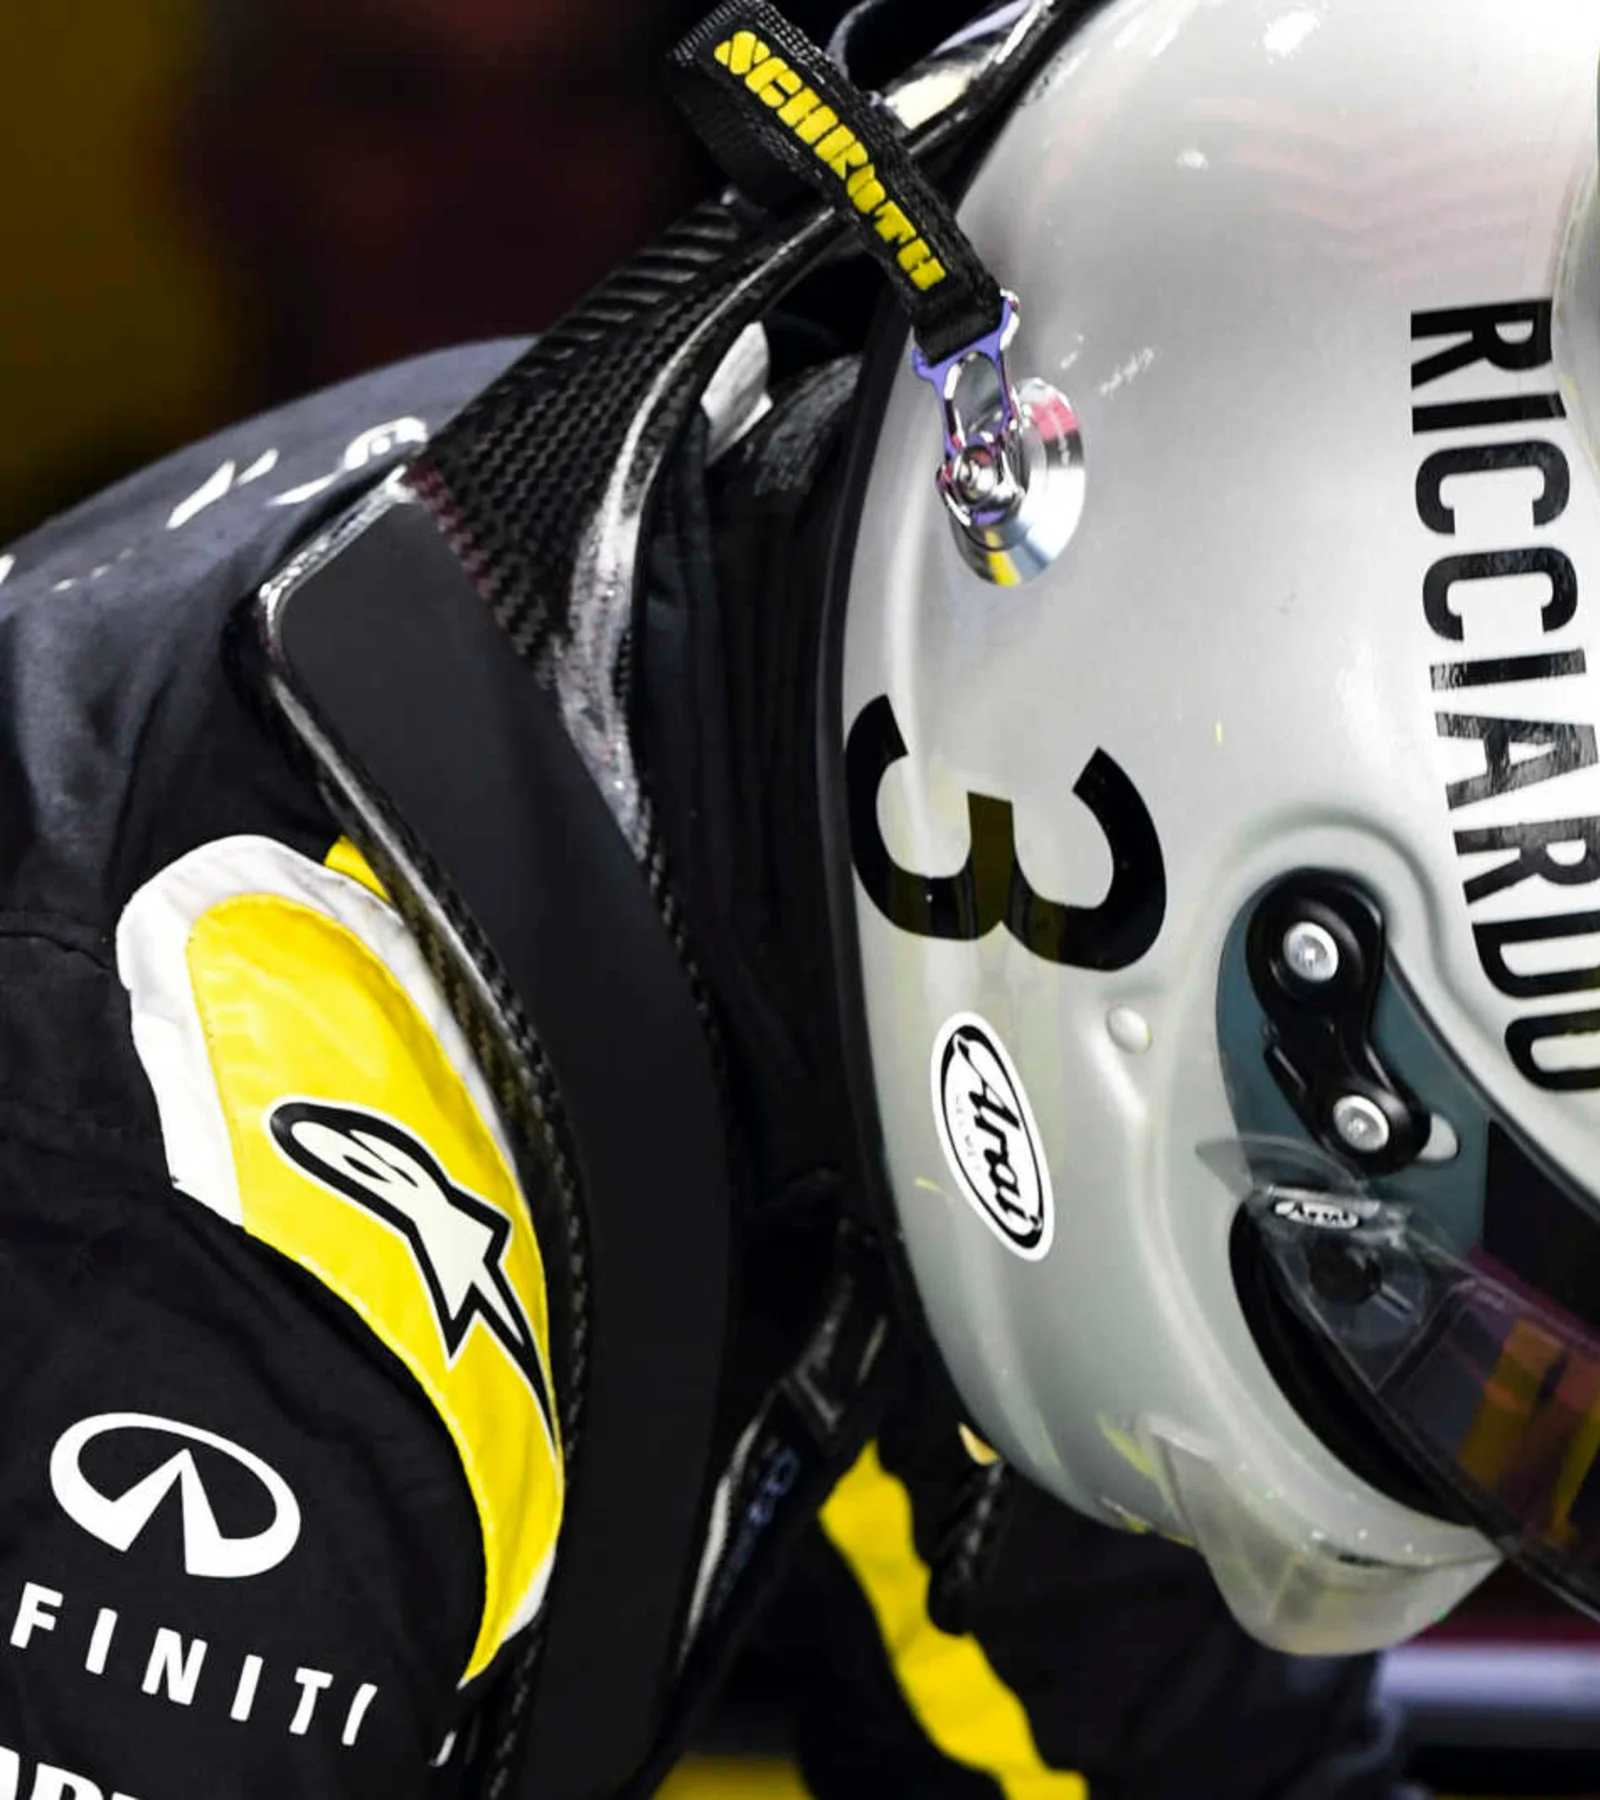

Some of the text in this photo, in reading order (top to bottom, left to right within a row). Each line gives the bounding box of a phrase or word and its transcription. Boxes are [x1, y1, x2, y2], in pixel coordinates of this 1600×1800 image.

[714, 31, 946, 291] SCHROTH
[846, 693, 1167, 972] 3
[957, 1037, 1041, 1229] Arai
